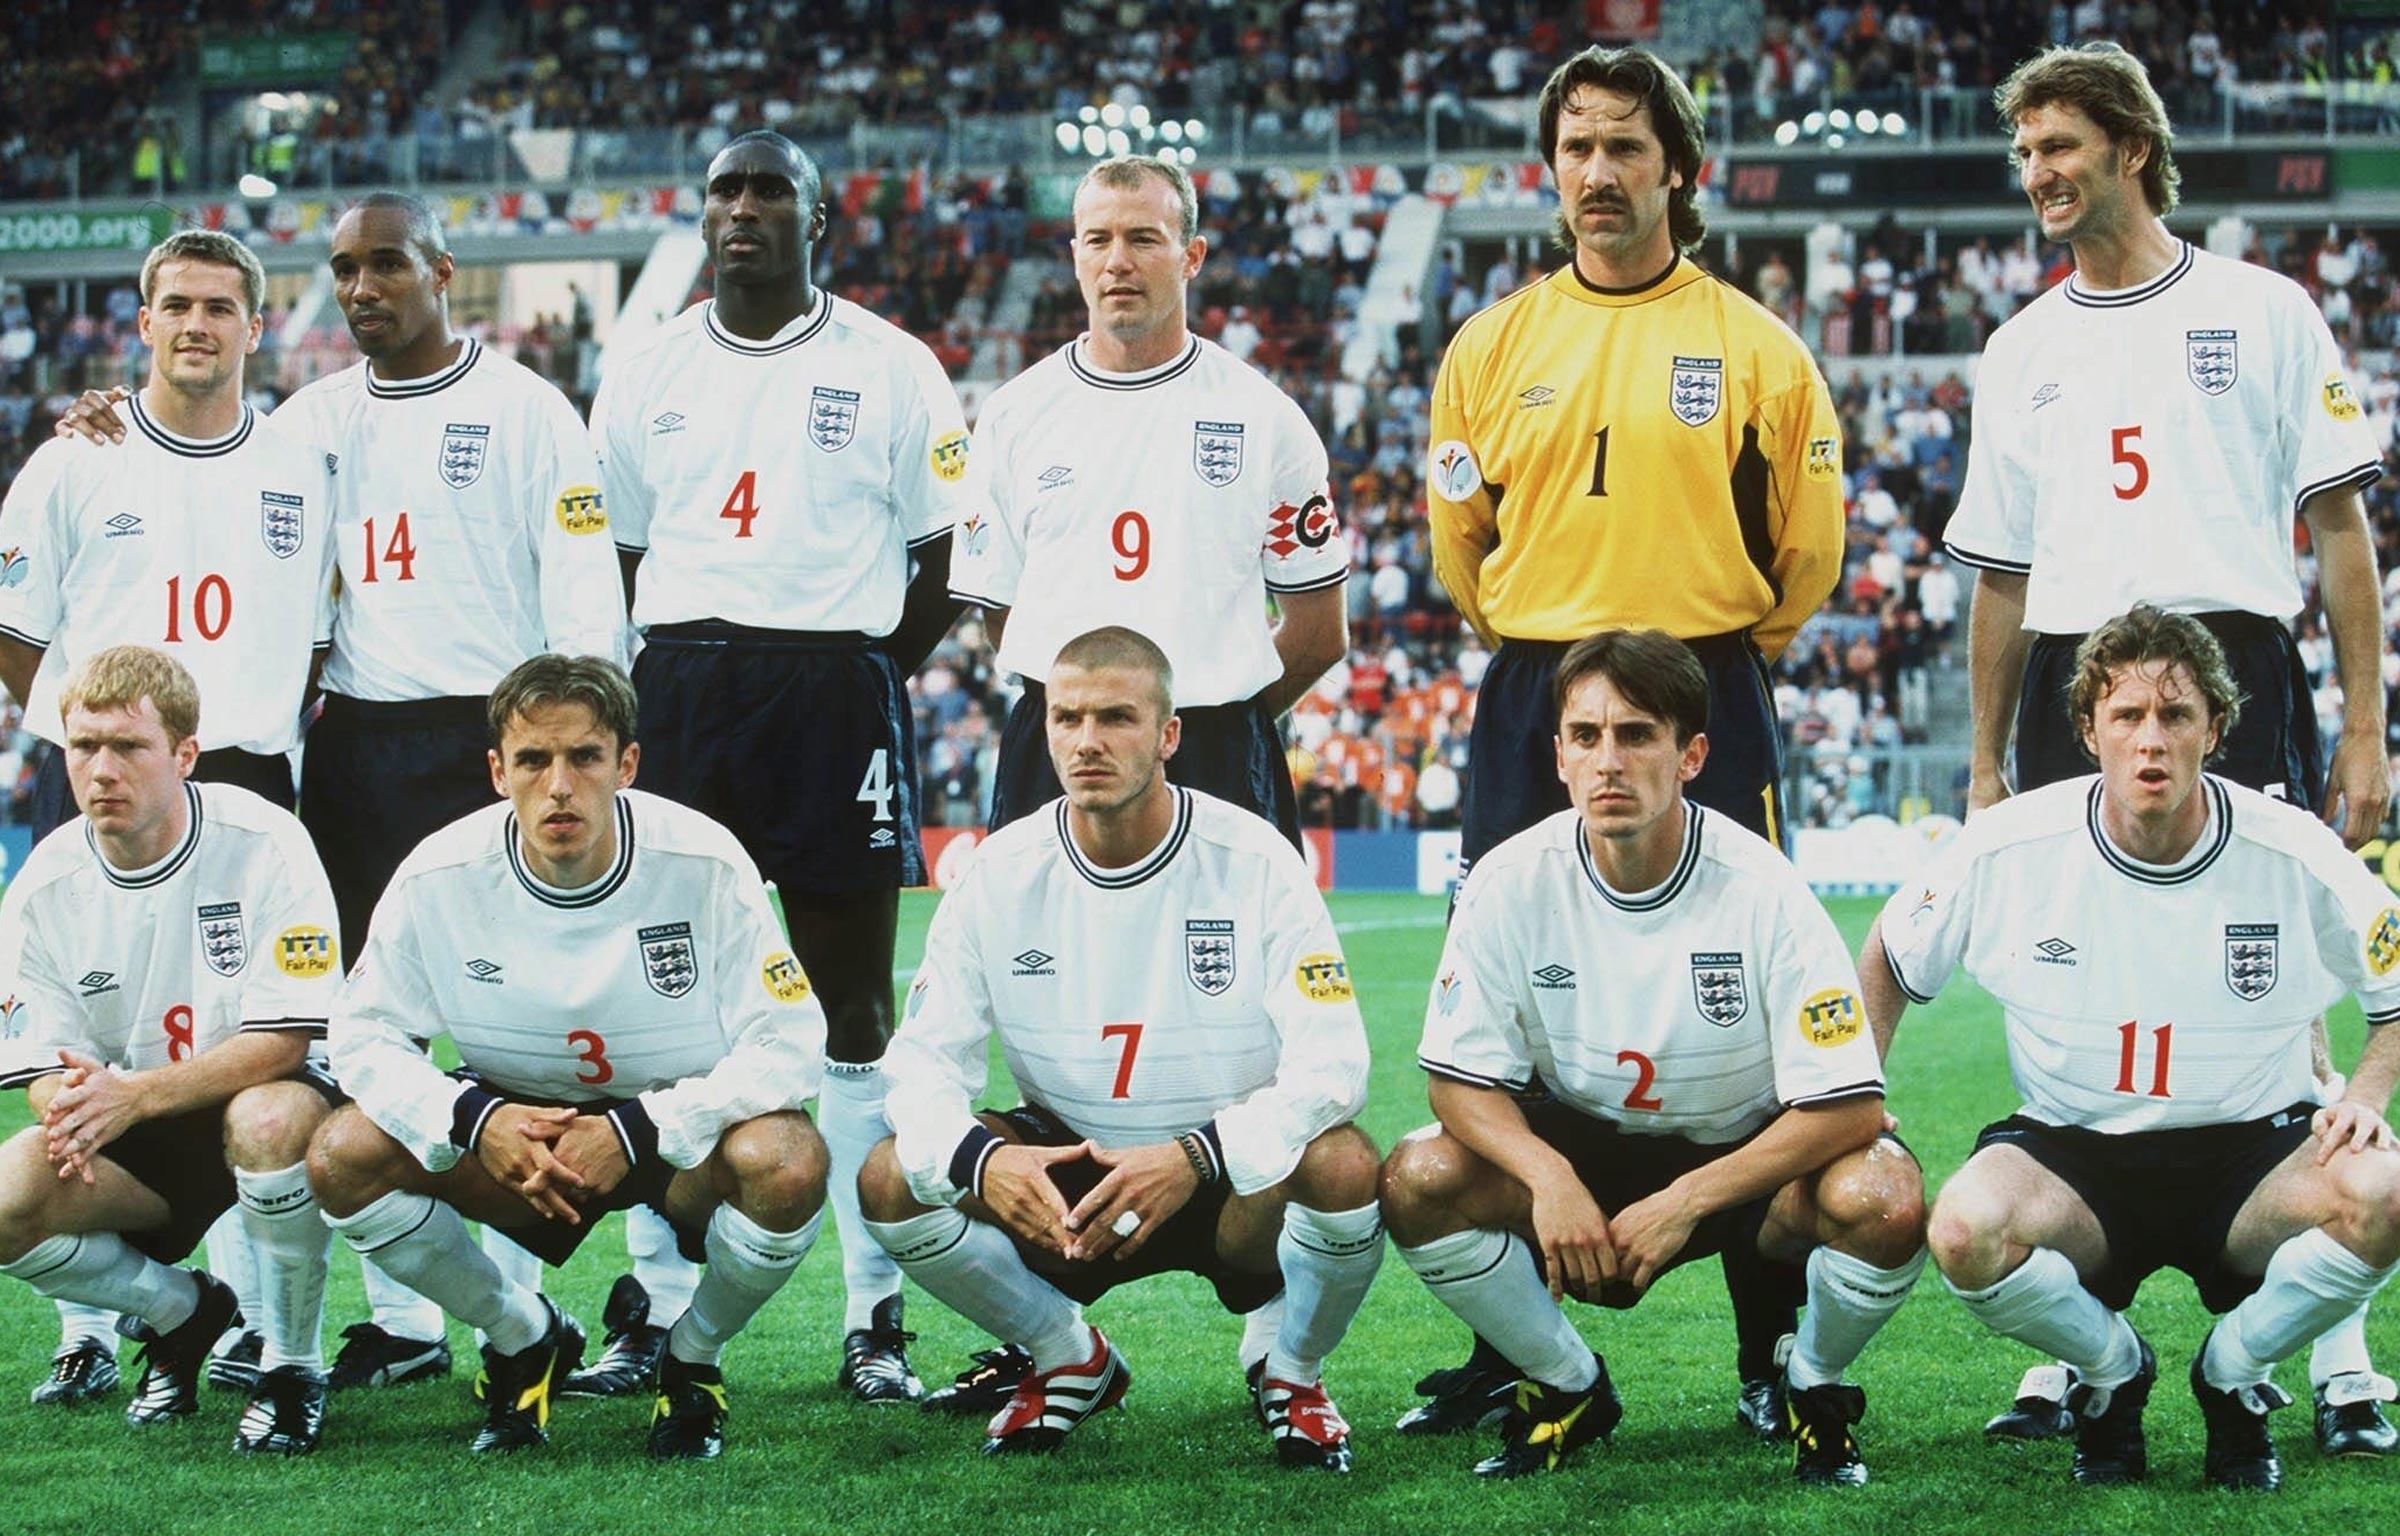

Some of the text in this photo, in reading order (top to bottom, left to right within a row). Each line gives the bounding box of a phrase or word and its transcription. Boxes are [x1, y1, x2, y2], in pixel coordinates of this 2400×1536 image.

[1676, 359, 1721, 368] ENGLAND
[815, 388, 859, 400] ENGLAND
[448, 425, 489, 434] ENGLAND
[1198, 422, 1242, 432] ENGLAND
[1585, 426, 1609, 496] 1
[2111, 425, 2148, 500] 5
[264, 493, 302, 505] ENGLAND
[720, 471, 758, 538] 4
[566, 516, 605, 529] Fair Play
[1295, 495, 1331, 548] C
[363, 512, 416, 583] 14
[1111, 511, 1151, 581] 9
[165, 574, 232, 642] 10
[857, 749, 894, 821] 4
[200, 904, 239, 915] ENGLAND
[641, 924, 688, 939] ENGLAND
[1189, 921, 1232, 930] ENGLAND
[2228, 926, 2277, 935] ENGLAND
[286, 959, 328, 971] Fair Play
[1694, 954, 1740, 964] ENGLAND
[2033, 955, 2077, 966] UMBRO
[1310, 987, 1329, 998] Fair
[1532, 981, 1577, 990] UMBRO
[163, 1005, 194, 1064] 8
[1813, 1024, 1858, 1042] Fair Play
[567, 1029, 613, 1084] 3
[1102, 1023, 1143, 1098] 7
[2114, 1020, 2172, 1097] 11
[1616, 1050, 1661, 1111] 2
